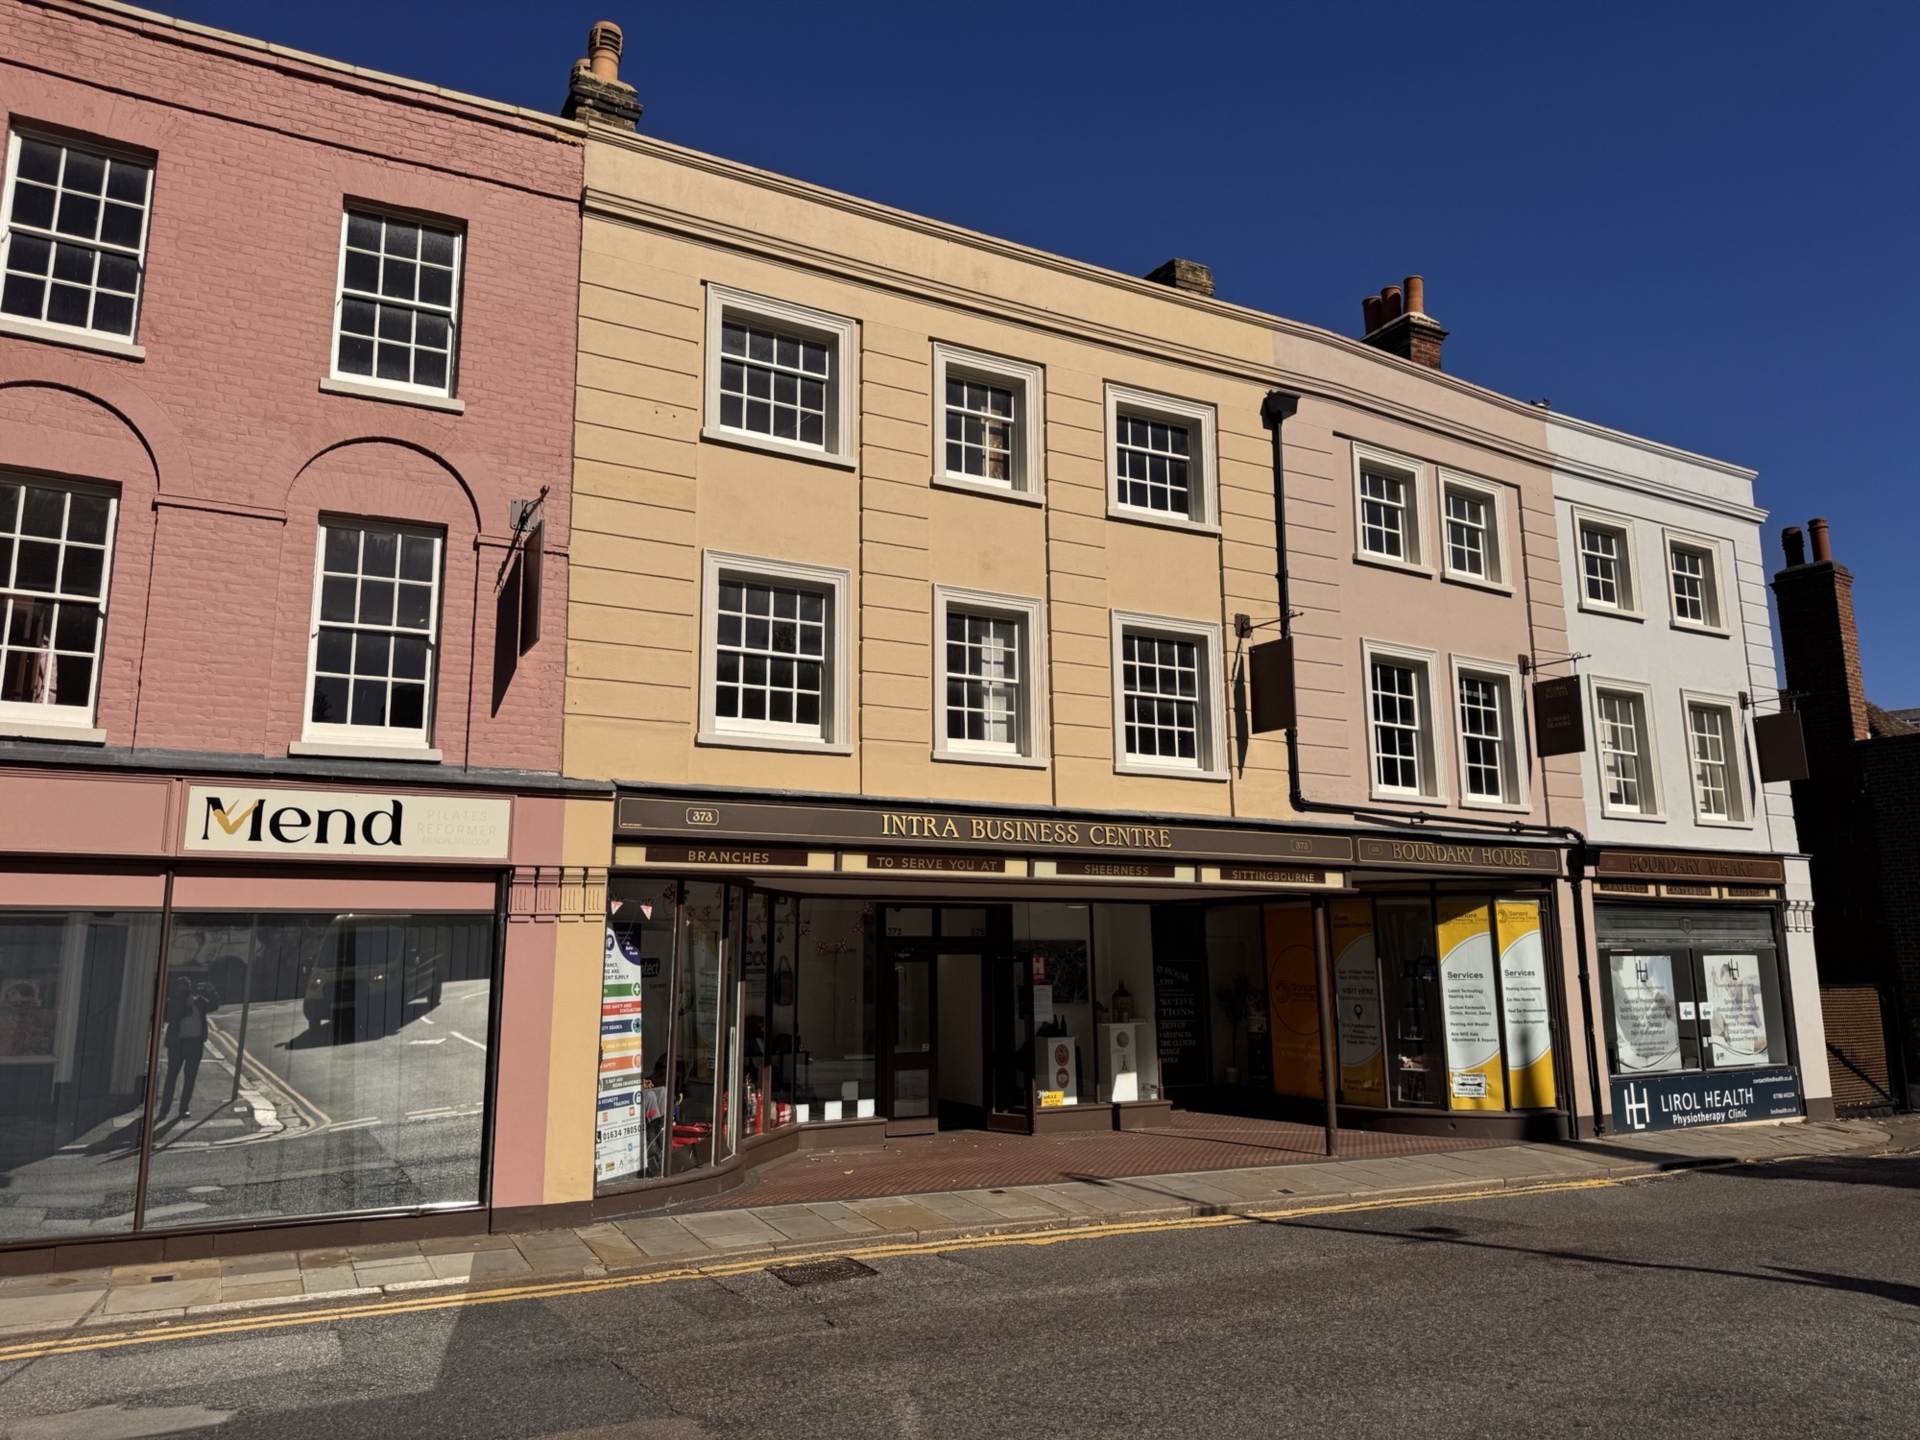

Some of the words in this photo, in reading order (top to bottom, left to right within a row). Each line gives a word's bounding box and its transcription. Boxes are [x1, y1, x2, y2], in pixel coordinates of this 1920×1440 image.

[202, 796, 403, 846] Mend
[693, 811, 713, 822] 373
[417, 823, 497, 836] REFORMER
[881, 814, 960, 839] INTRA
[971, 817, 1079, 844] BUSINESS
[1089, 826, 1172, 849] CENTRE
[688, 850, 769, 863] BRANCHES
[1392, 842, 1474, 864] BOUNDARY
[1482, 848, 1530, 866] HOUSE
[876, 856, 894, 867] TO
[901, 858, 943, 869] SERVE
[951, 859, 975, 870] YOU
[981, 861, 997, 872] AT
[1084, 864, 1150, 875] SHEERNESS
[1629, 856, 1702, 875] BOUNDARY
[1709, 859, 1753, 877] WHARF
[1231, 870, 1315, 882] SITTINGBOURNE
[1447, 971, 1484, 979] Services
[1504, 969, 1535, 978] Services
[1660, 1092, 1701, 1112] LIROL
[1704, 1087, 1754, 1108] HEALTH
[1672, 1110, 1725, 1126] Physiotherapy
[1728, 1107, 1748, 1120] Clinic
[603, 1129, 622, 1140] 01634
